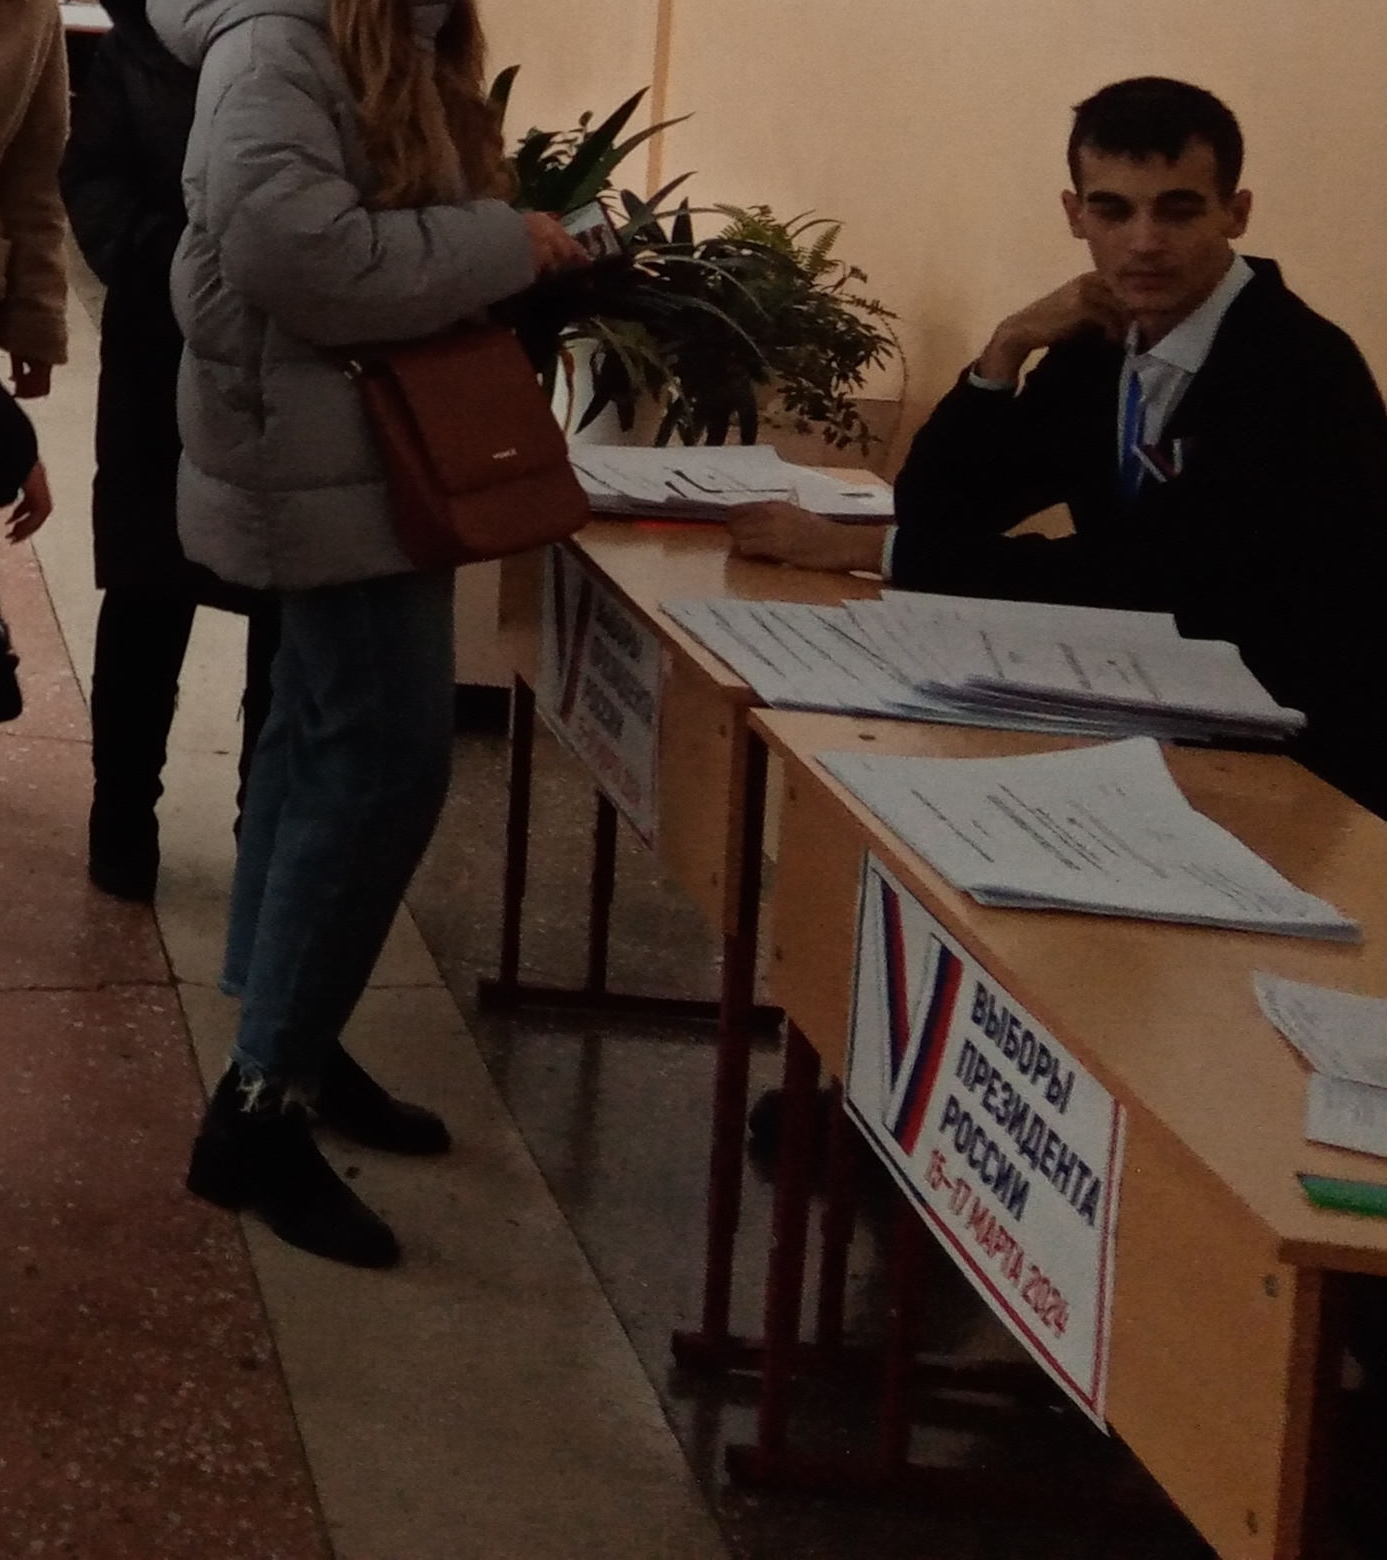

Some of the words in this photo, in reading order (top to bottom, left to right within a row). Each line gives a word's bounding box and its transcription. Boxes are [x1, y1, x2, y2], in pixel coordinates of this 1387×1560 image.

[969, 981, 1075, 1115] ВЫБОРЫ
[939, 1095, 1031, 1222] РОССИИ
[954, 1039, 1103, 1228] ПРЕЗИДЕНТА
[1021, 1264, 1070, 1339] 2024
